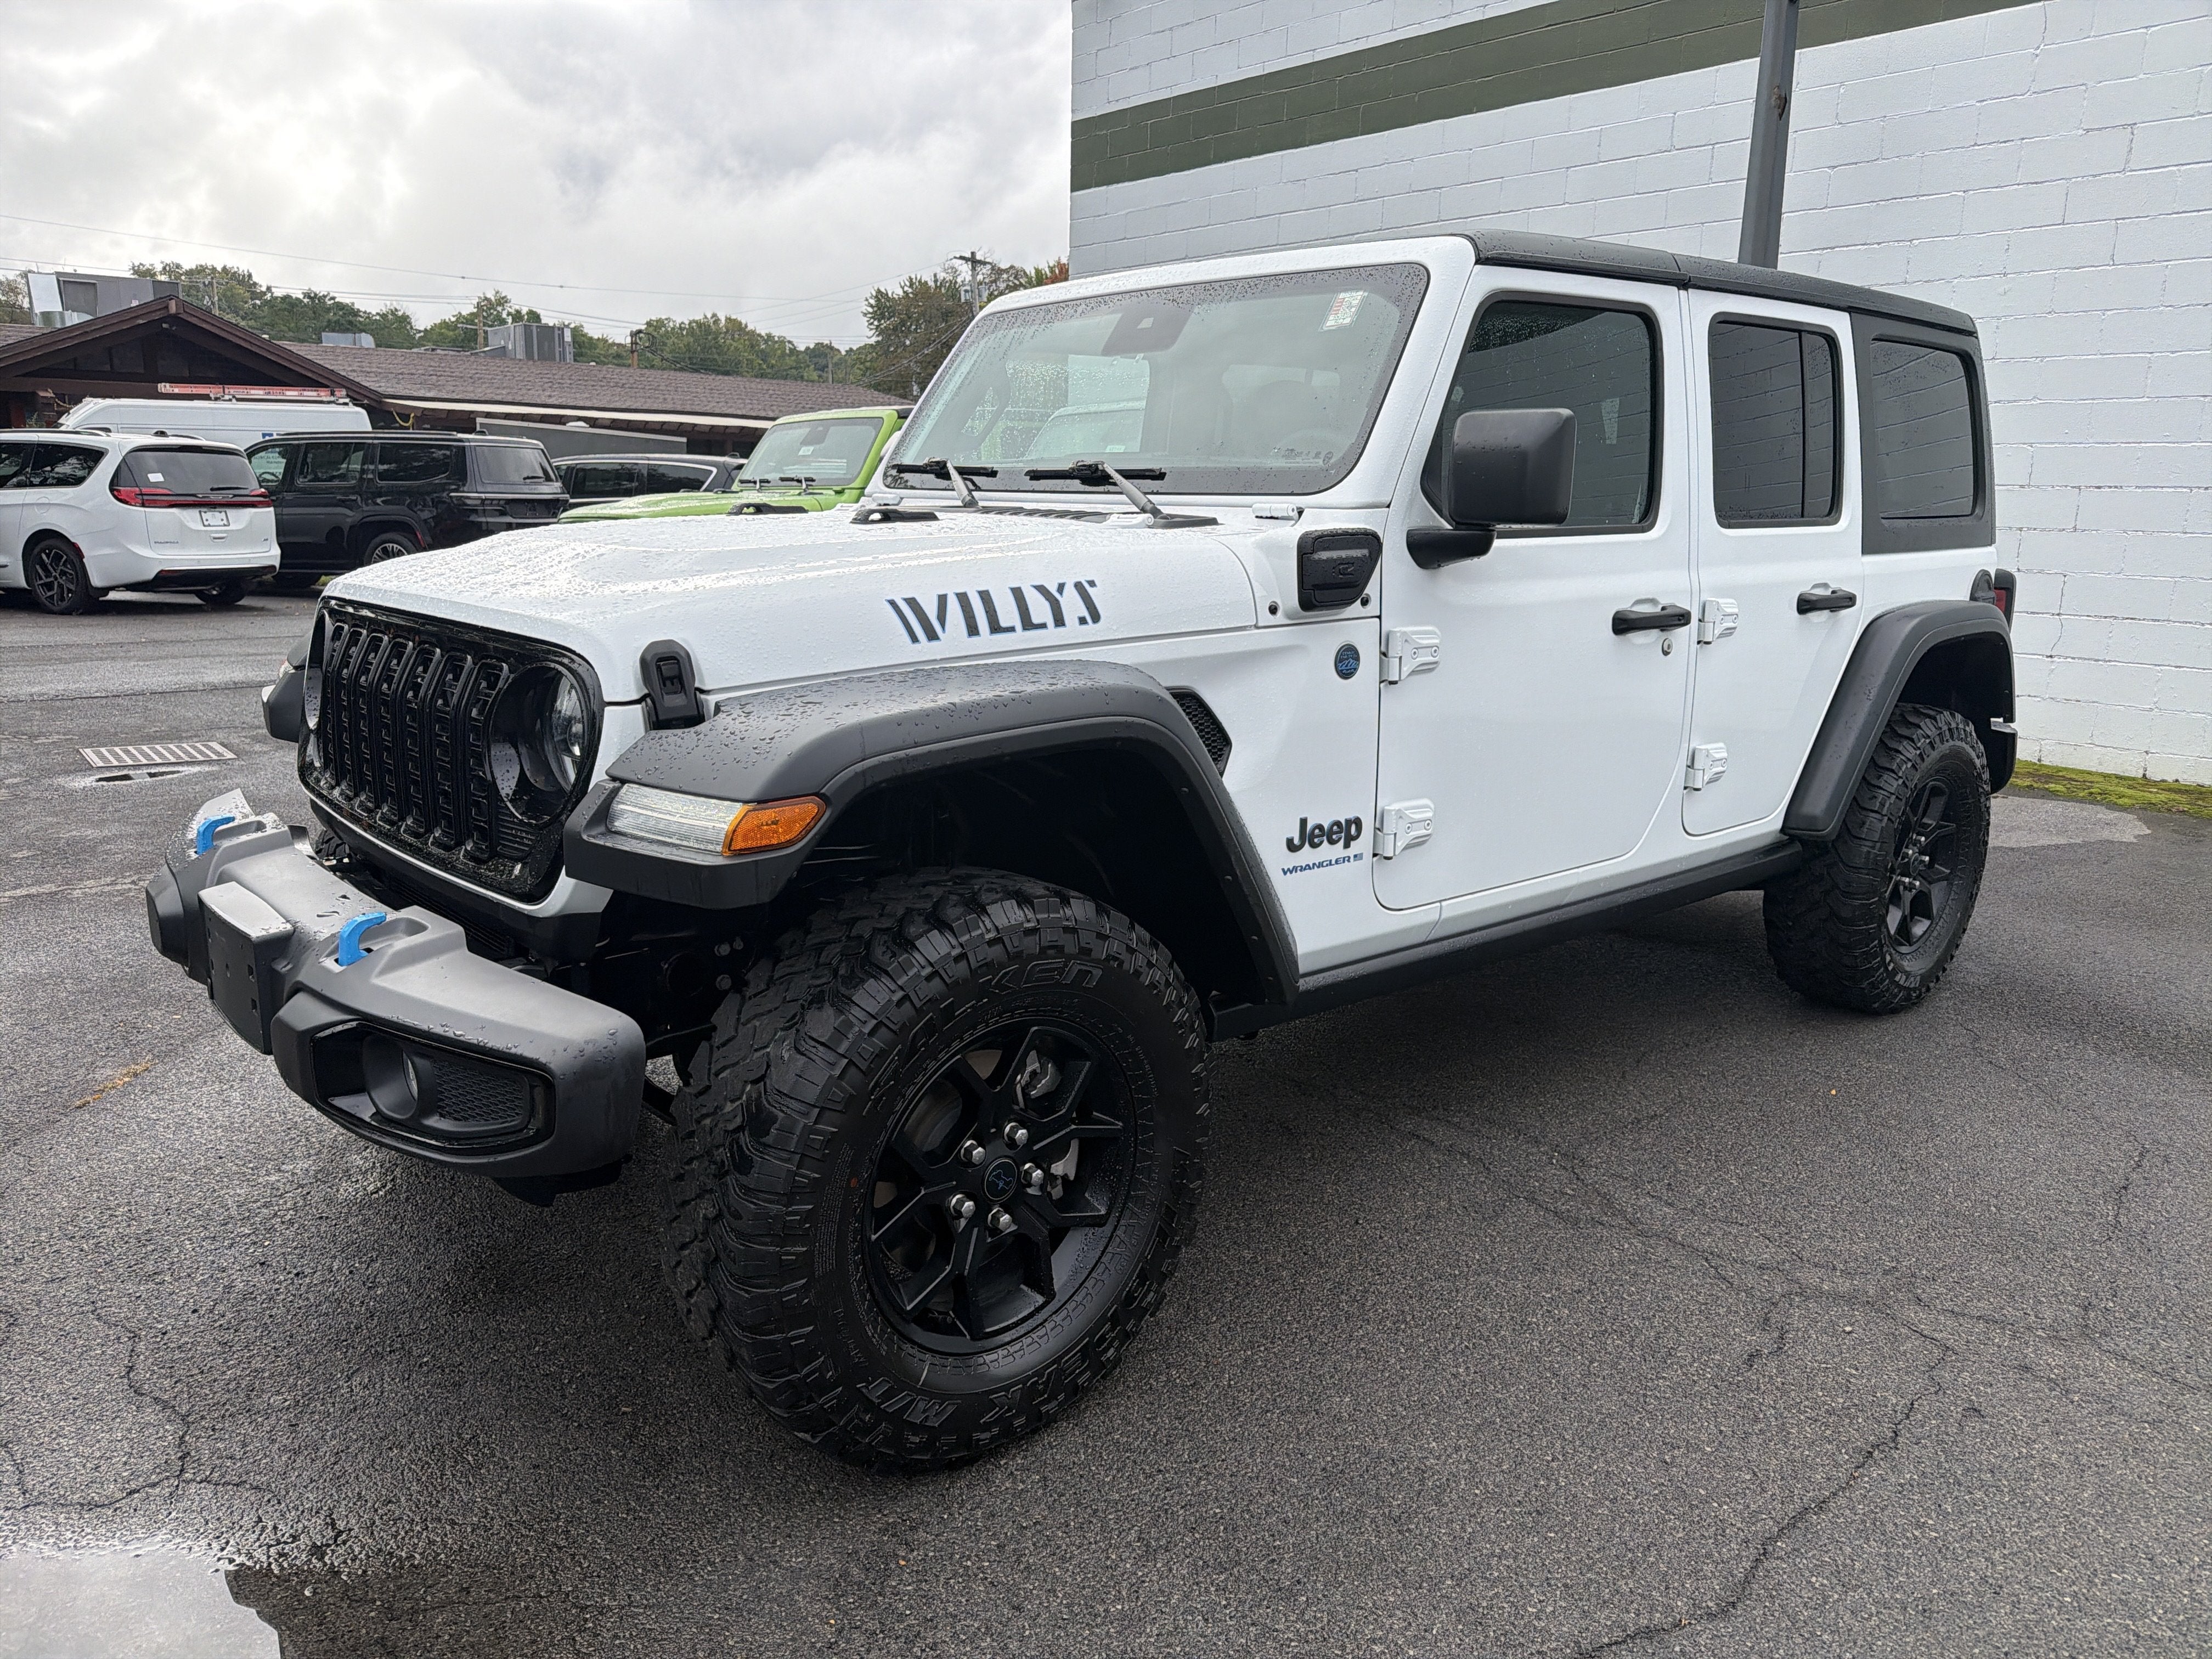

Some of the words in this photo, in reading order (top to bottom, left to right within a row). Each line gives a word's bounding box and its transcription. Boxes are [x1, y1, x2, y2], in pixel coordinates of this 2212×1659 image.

[885, 579, 1102, 645] WILLYS
[1285, 815, 1363, 853] Jeep
[1281, 855, 1351, 876] WRANGLER
[854, 1373, 962, 1427] M/T
